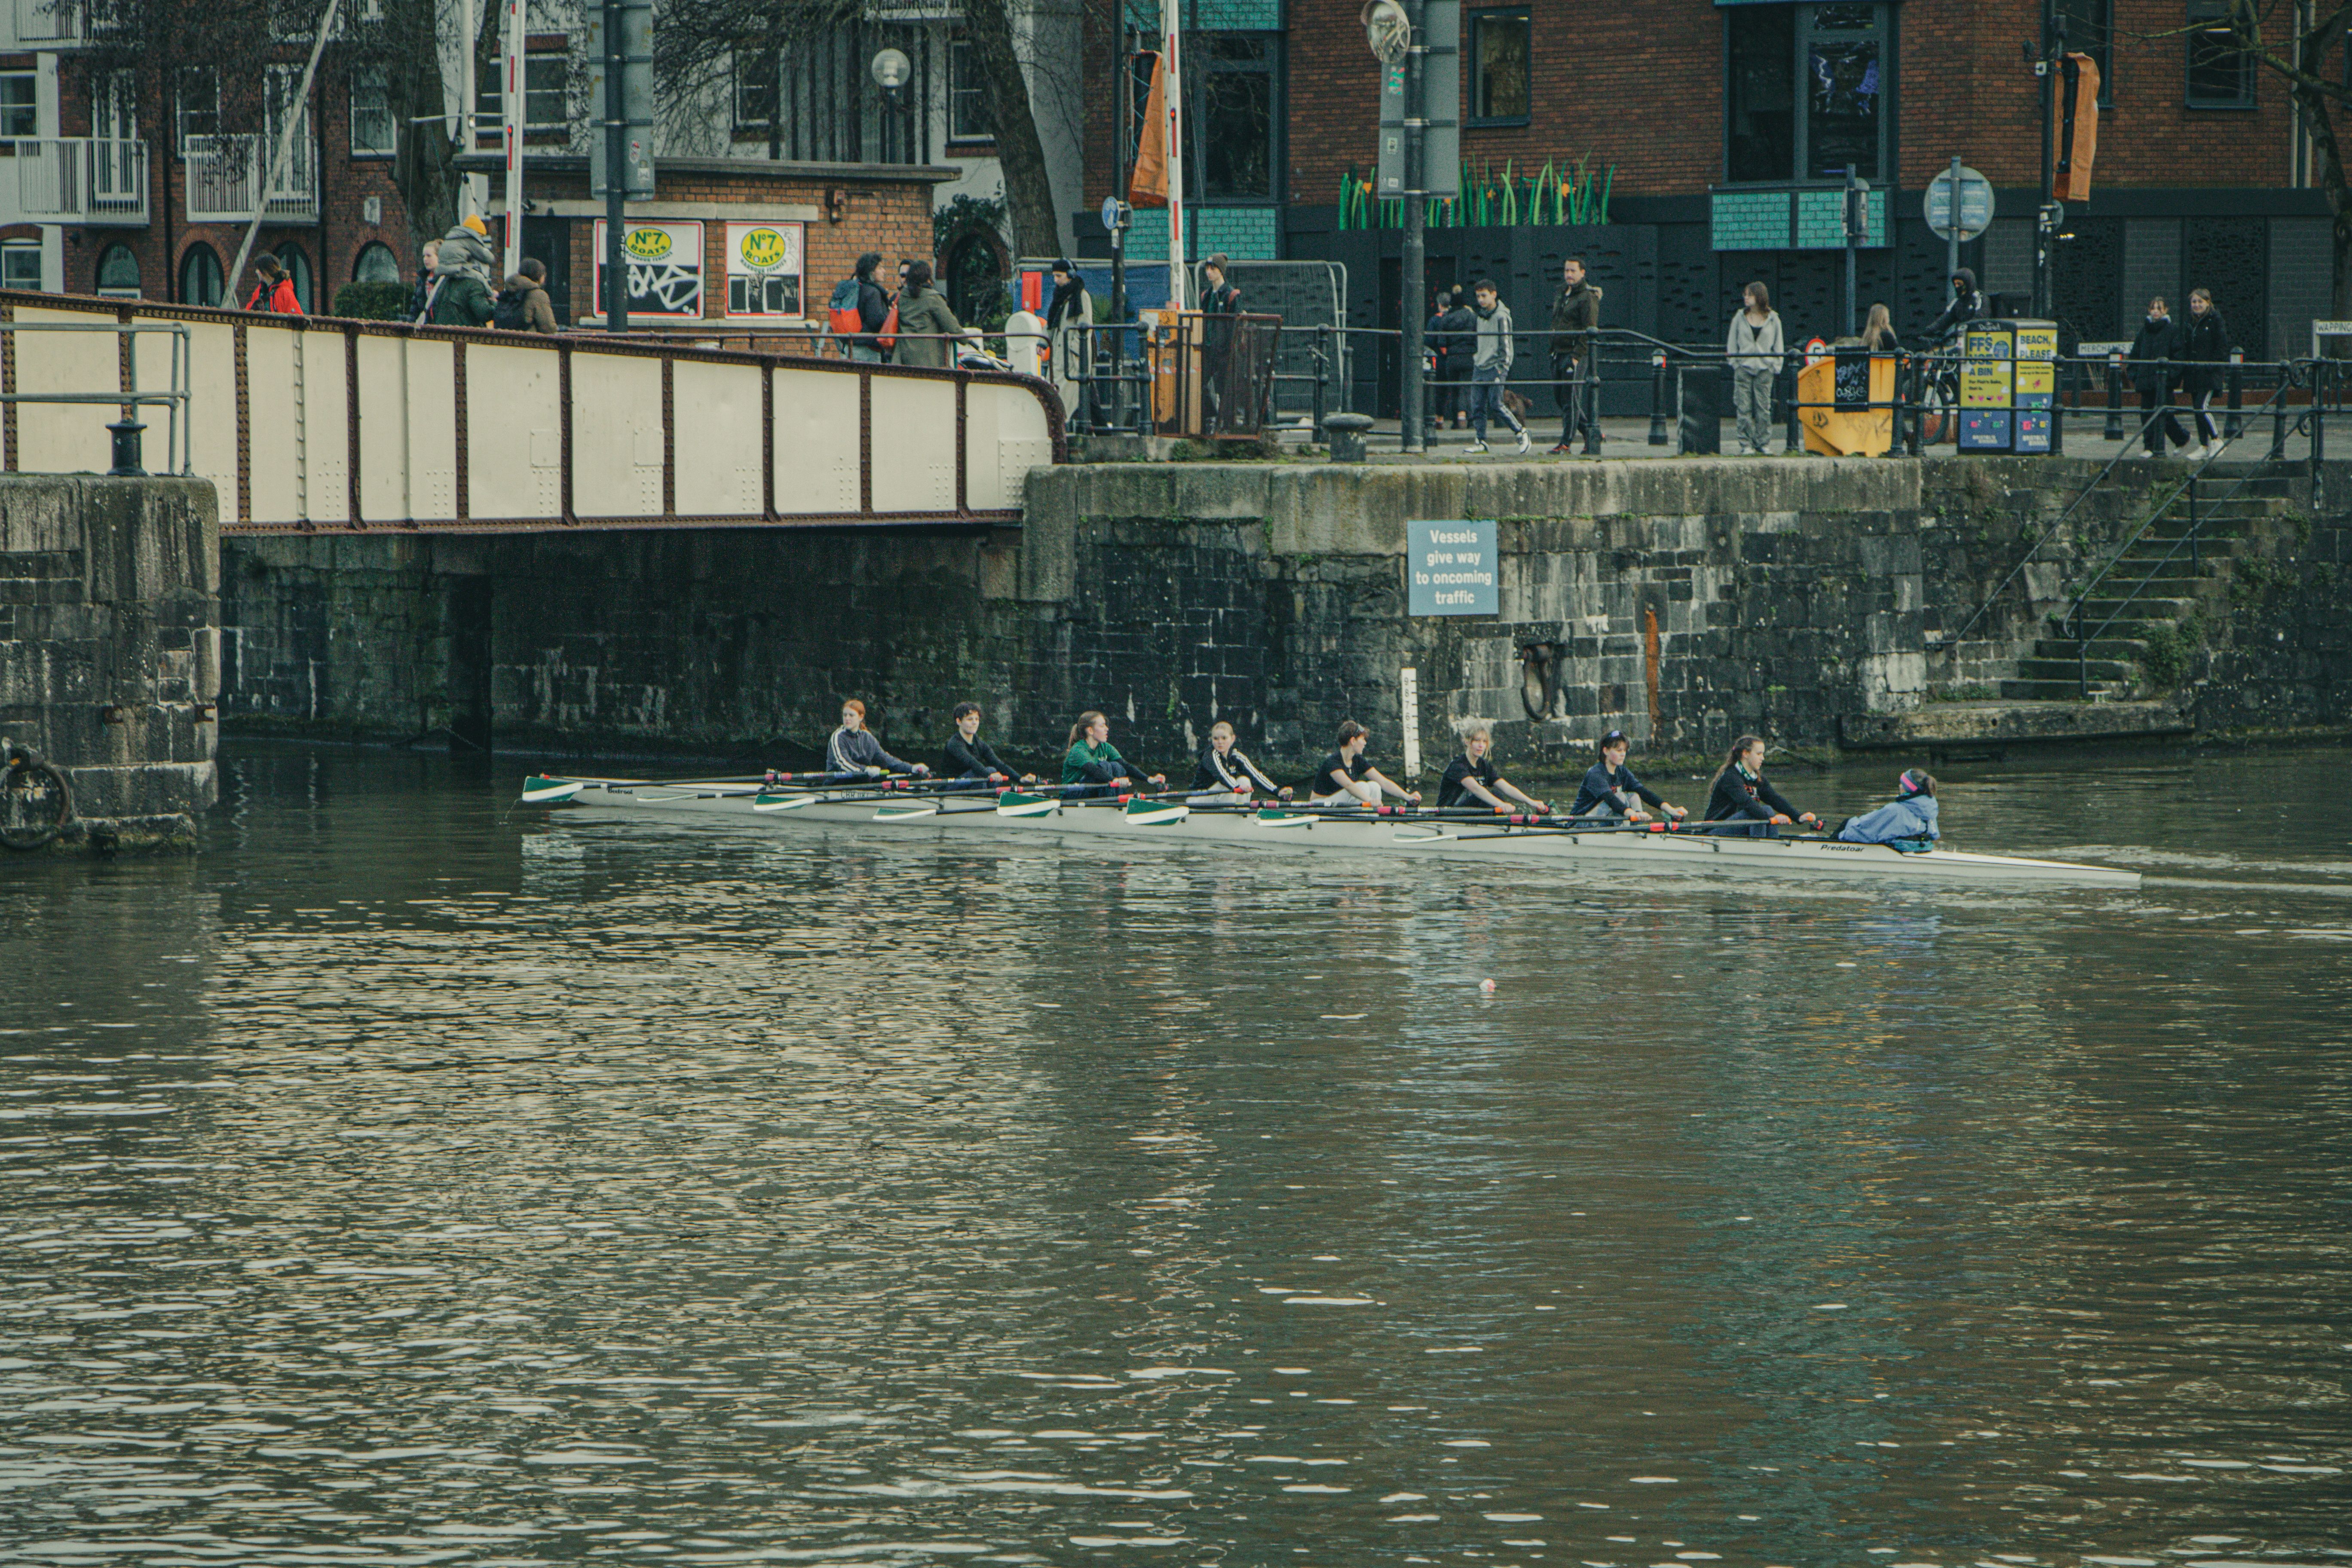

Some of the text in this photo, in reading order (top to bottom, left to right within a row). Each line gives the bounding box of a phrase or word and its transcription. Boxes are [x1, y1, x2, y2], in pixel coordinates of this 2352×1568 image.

[631, 244, 666, 254] BOATS
[745, 250, 781, 263] BOATS
[2318, 322, 2352, 331] WAPPING
[1969, 337, 1993, 352] FFS
[1969, 368, 1993, 376] A BIN
[1430, 530, 1478, 544] Vessels
[1427, 550, 1481, 567] give way
[1415, 570, 1492, 585] to oncoming
[1435, 590, 1475, 605] traffic
[1404, 677, 1409, 686] 9
[1405, 689, 1409, 697] 8
[1405, 700, 1409, 709] 7
[1405, 712, 1410, 721] 6
[1820, 844, 1865, 852] Predatoar
